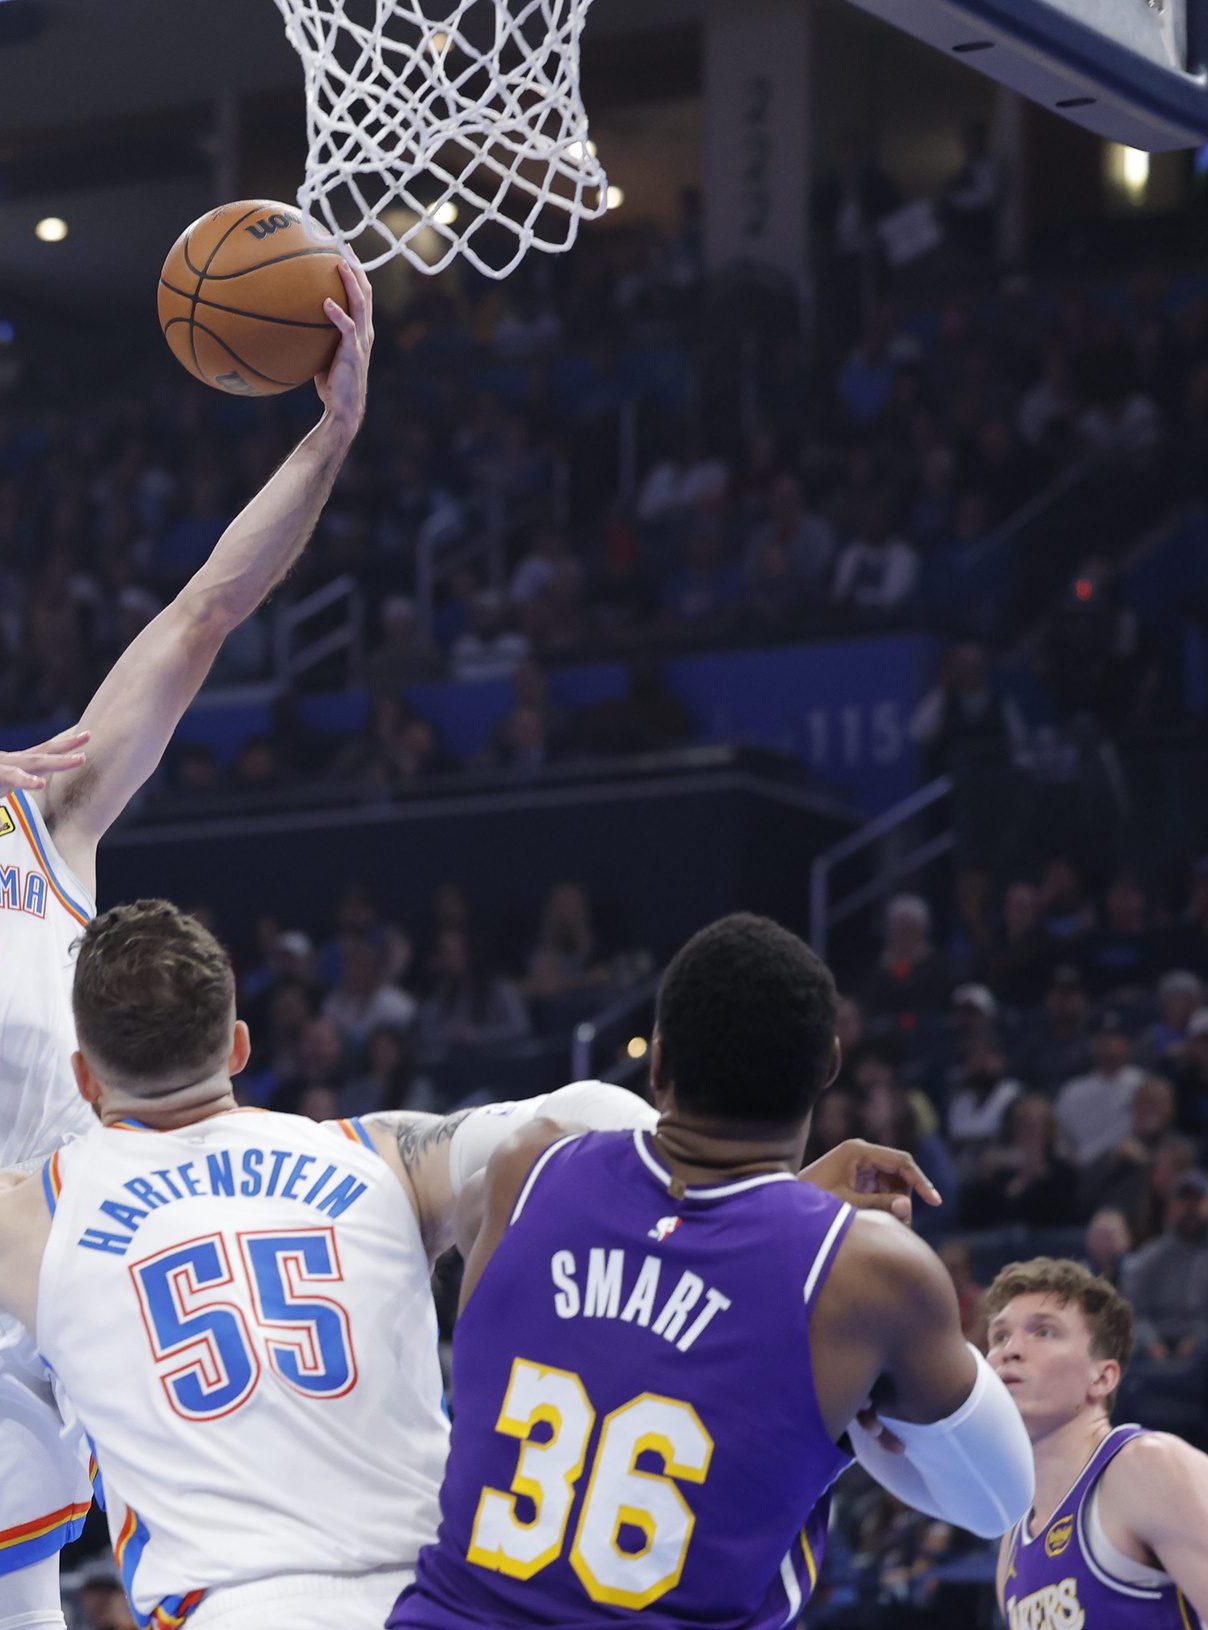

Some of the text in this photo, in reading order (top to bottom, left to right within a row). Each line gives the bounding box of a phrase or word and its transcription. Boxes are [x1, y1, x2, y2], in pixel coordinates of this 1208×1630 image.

[808, 701, 902, 766] 115
[78, 1148, 368, 1256] HARTENSTEIN
[128, 1226, 359, 1422] 55
[551, 1247, 732, 1353] SMART
[466, 1356, 715, 1611] 36
